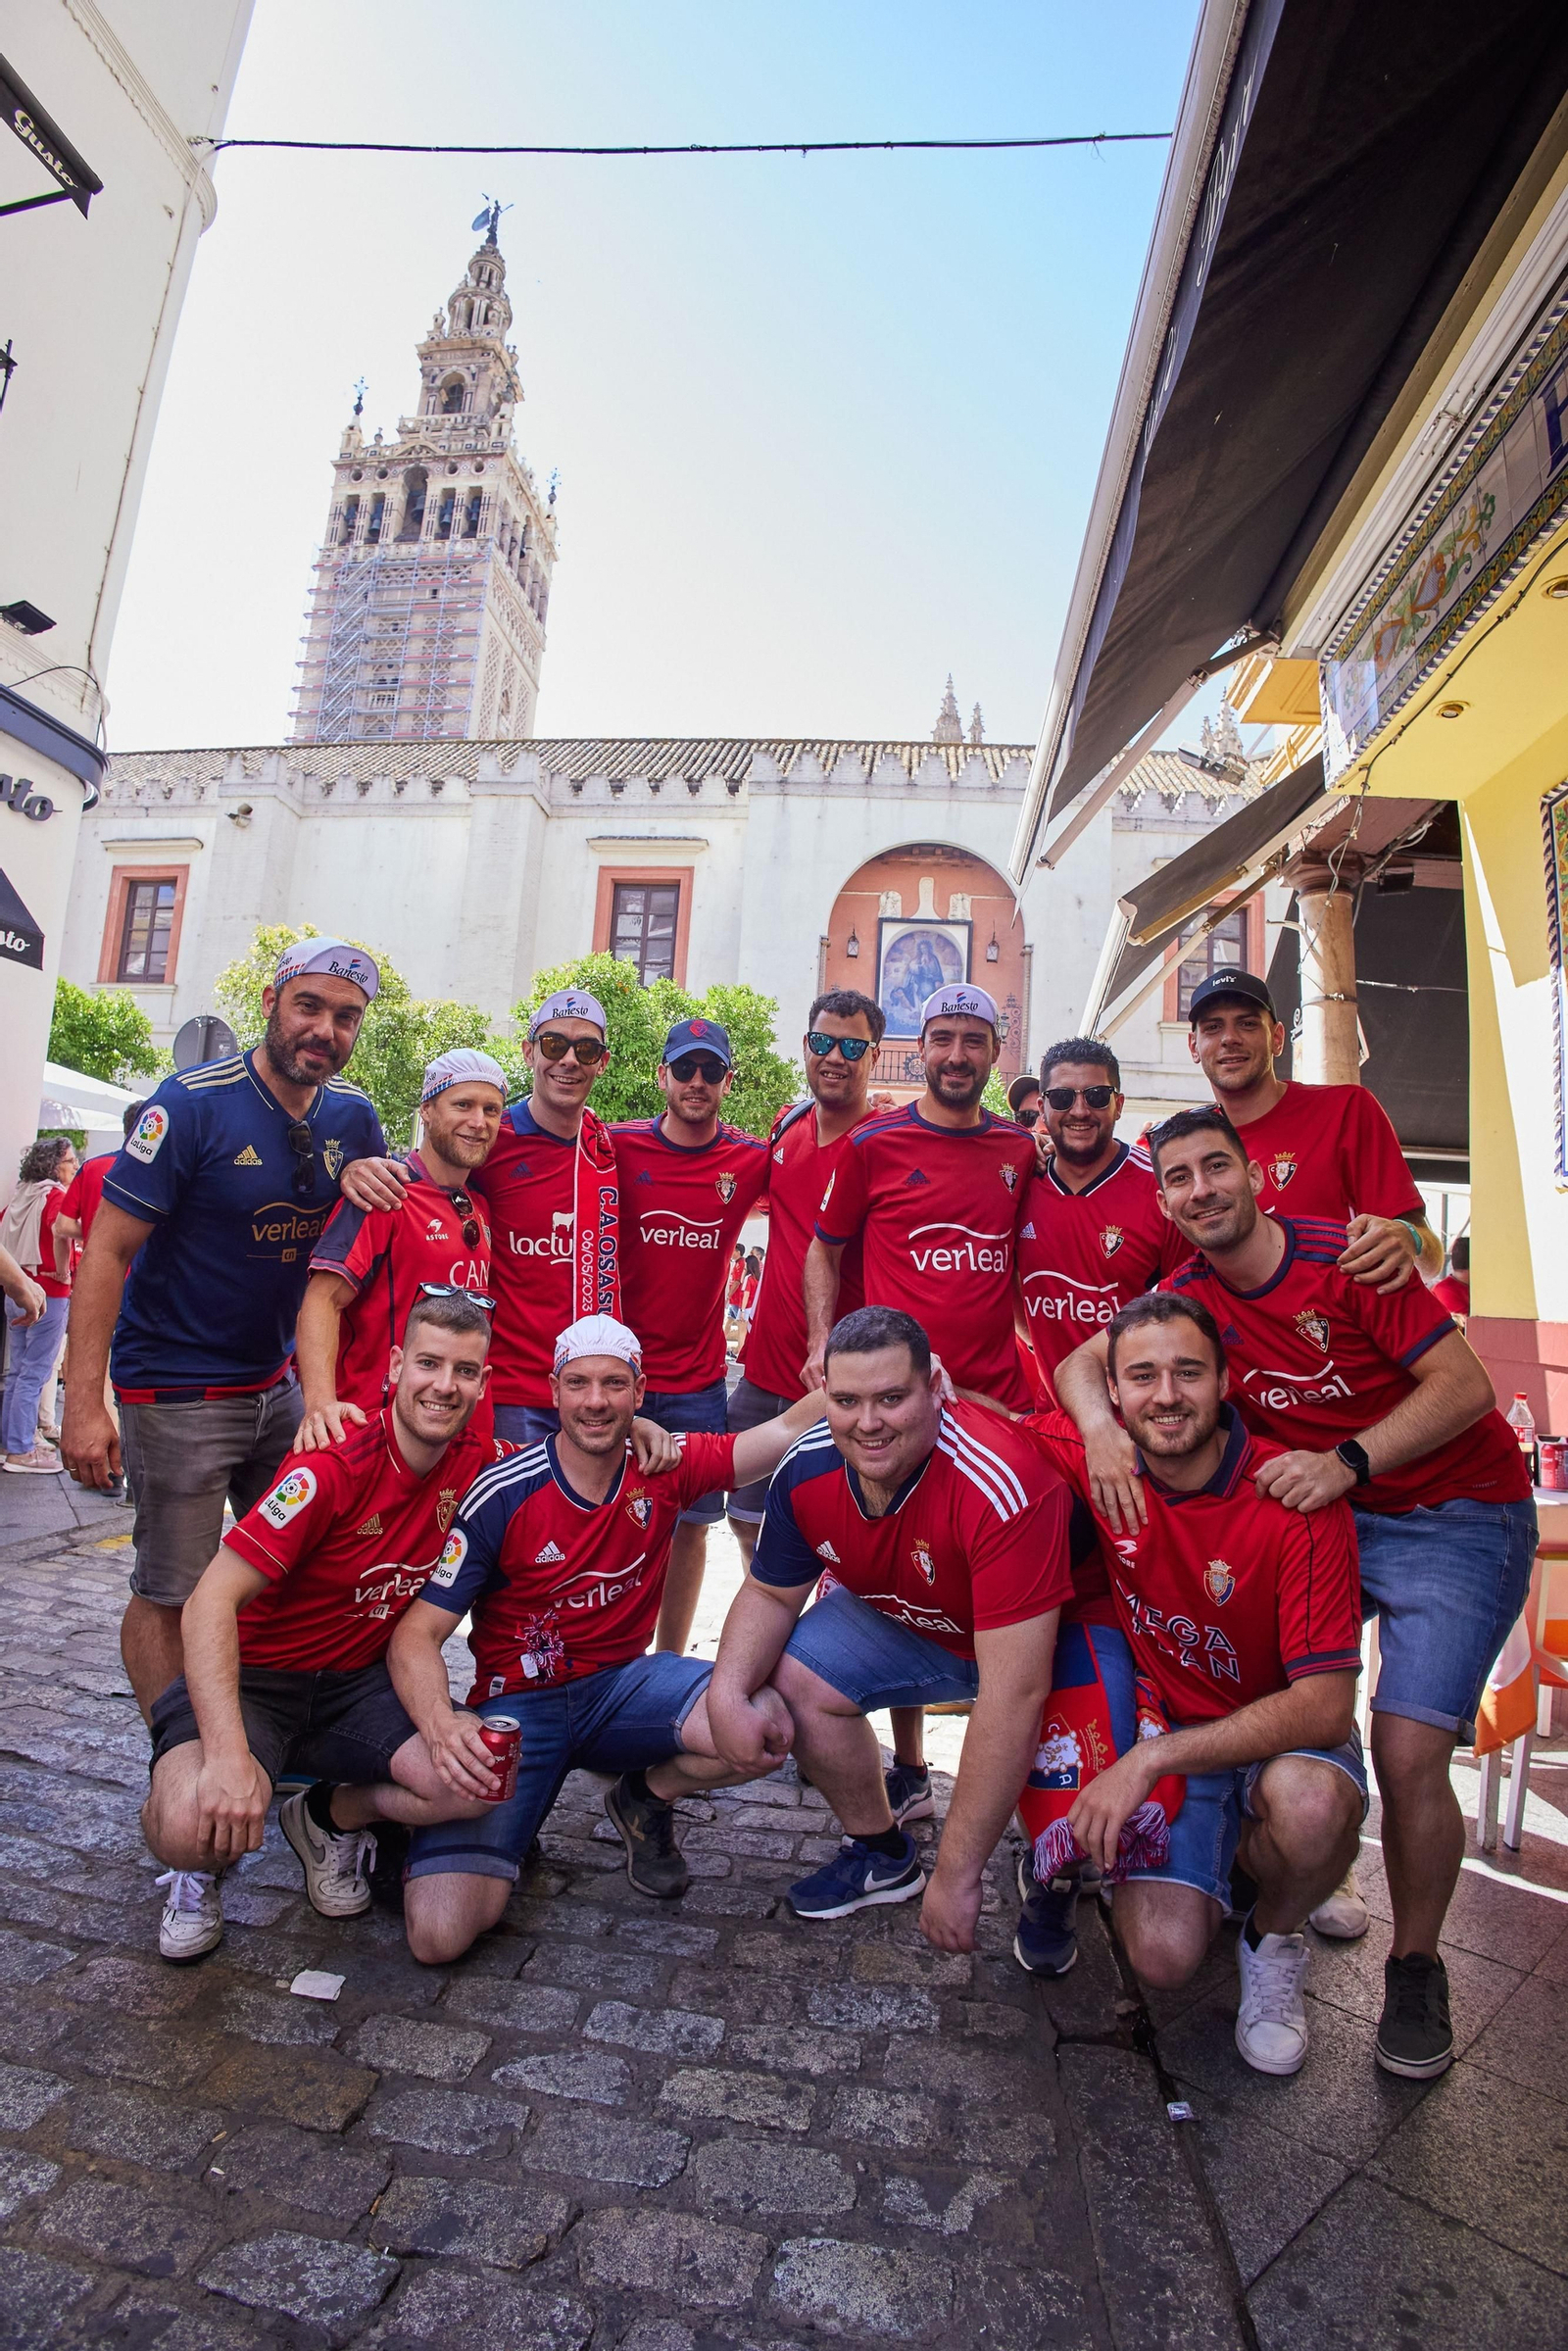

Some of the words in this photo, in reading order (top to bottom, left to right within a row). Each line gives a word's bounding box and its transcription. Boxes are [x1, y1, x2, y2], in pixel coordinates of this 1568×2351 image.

[15, 109, 78, 188] Gusto
[328, 961, 368, 984] Banesto
[552, 1006, 589, 1018] Banesto
[941, 1002, 979, 1012] Banesto
[130, 1138, 153, 1155] LaLiga
[640, 1225, 720, 1249] verleal
[910, 1242, 1009, 1273] verleal
[580, 1229, 594, 1312] 06/05/2023
[535, 1553, 565, 1563] adidas
[355, 1571, 433, 1603] verlea
